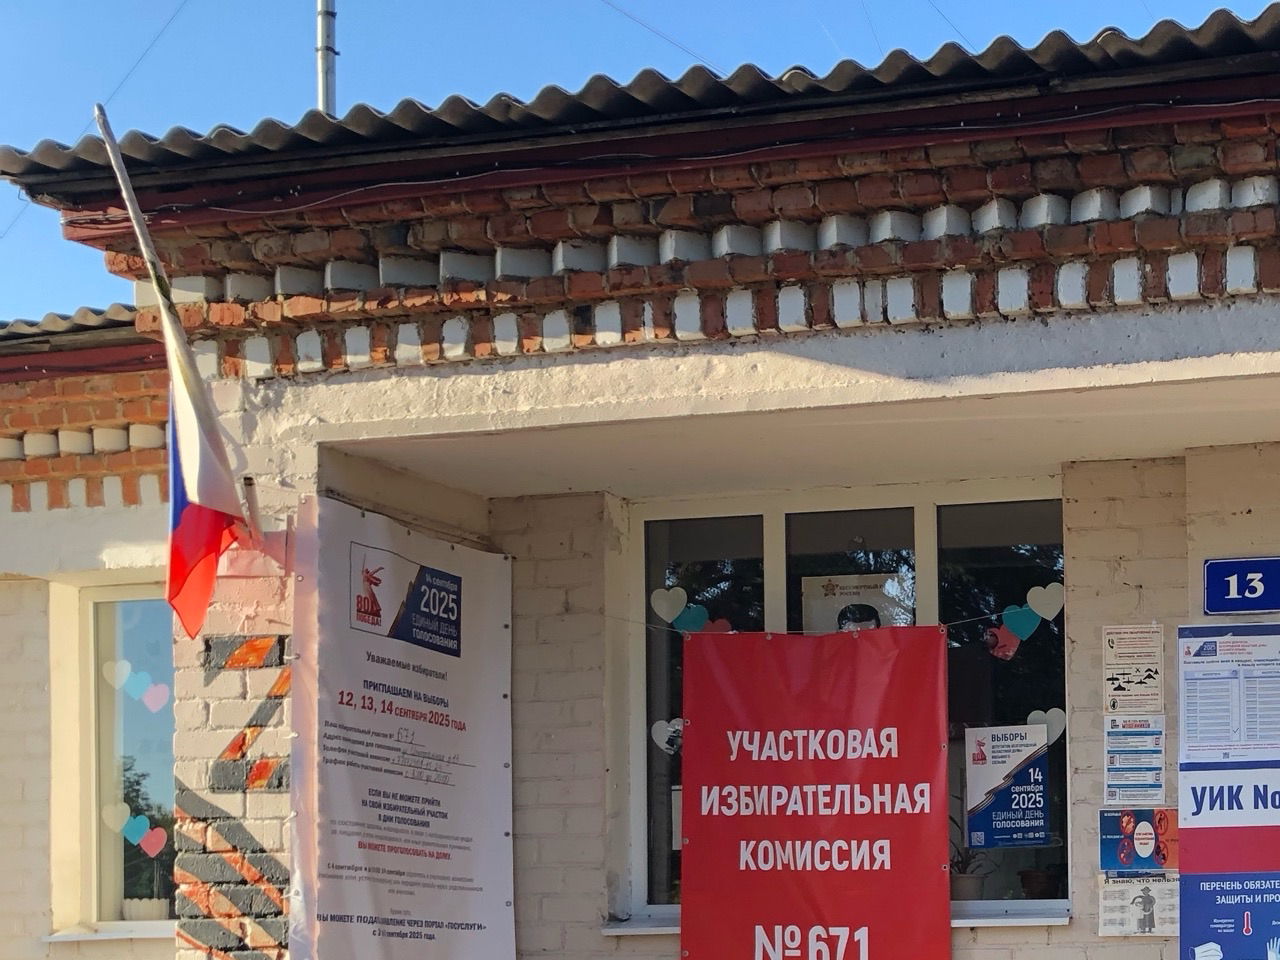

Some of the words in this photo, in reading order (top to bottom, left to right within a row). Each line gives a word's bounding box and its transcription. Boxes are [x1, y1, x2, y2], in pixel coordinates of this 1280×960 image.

[1224, 572, 1265, 600] 13
[420, 585, 458, 621] 2025
[412, 612, 439, 632] ЕДИНЫЙ
[440, 622, 458, 637] ДЕНЬ
[412, 627, 458, 650] голосования
[366, 651, 411, 671] Уважаемые
[363, 679, 413, 700] ПРИГЛАШАЕМ
[414, 691, 422, 701] НА
[423, 693, 449, 709] ВЫБОРЫ
[338, 690, 357, 710] 12,
[361, 695, 377, 713] 13,
[381, 699, 393, 715] 14
[395, 706, 428, 722] СЕНТЯБРЯ
[428, 710, 450, 727] 2025
[451, 720, 467, 732] ГОДА
[323, 732, 342, 742] Адрес
[727, 727, 899, 762] УЧАСТКОВАЯ
[991, 732, 1027, 742] ВЫБОРЫ
[1028, 768, 1043, 783] 14
[368, 788, 382, 797] ЕСЛИ
[382, 791, 391, 799] ВЫ
[1011, 784, 1043, 793] сентября
[701, 783, 931, 816] ИЗБИРАТЕЛЬНАЯ
[1011, 793, 1044, 809] 2025
[1191, 784, 1243, 816] УИК
[394, 816, 430, 828] ГОЛОСОВАНИЯ
[992, 809, 1024, 821] ЕДИНЫЙ
[1025, 810, 1044, 821] ДЕНЬ
[992, 819, 1044, 829] голосования
[358, 841, 367, 850] ВЫ
[739, 839, 892, 871] КОМИССИЯ
[1200, 881, 1242, 891] ПЕРЕЧЕНЬ
[1215, 895, 1253, 905] ЗАЩИТЫ
[1255, 895, 1262, 903] И
[330, 914, 354, 924] МОЖЕТЕ
[407, 918, 423, 928] ЧЕРЕЗ
[424, 920, 444, 929] ПОРТАЛ
[409, 931, 422, 939] 2025
